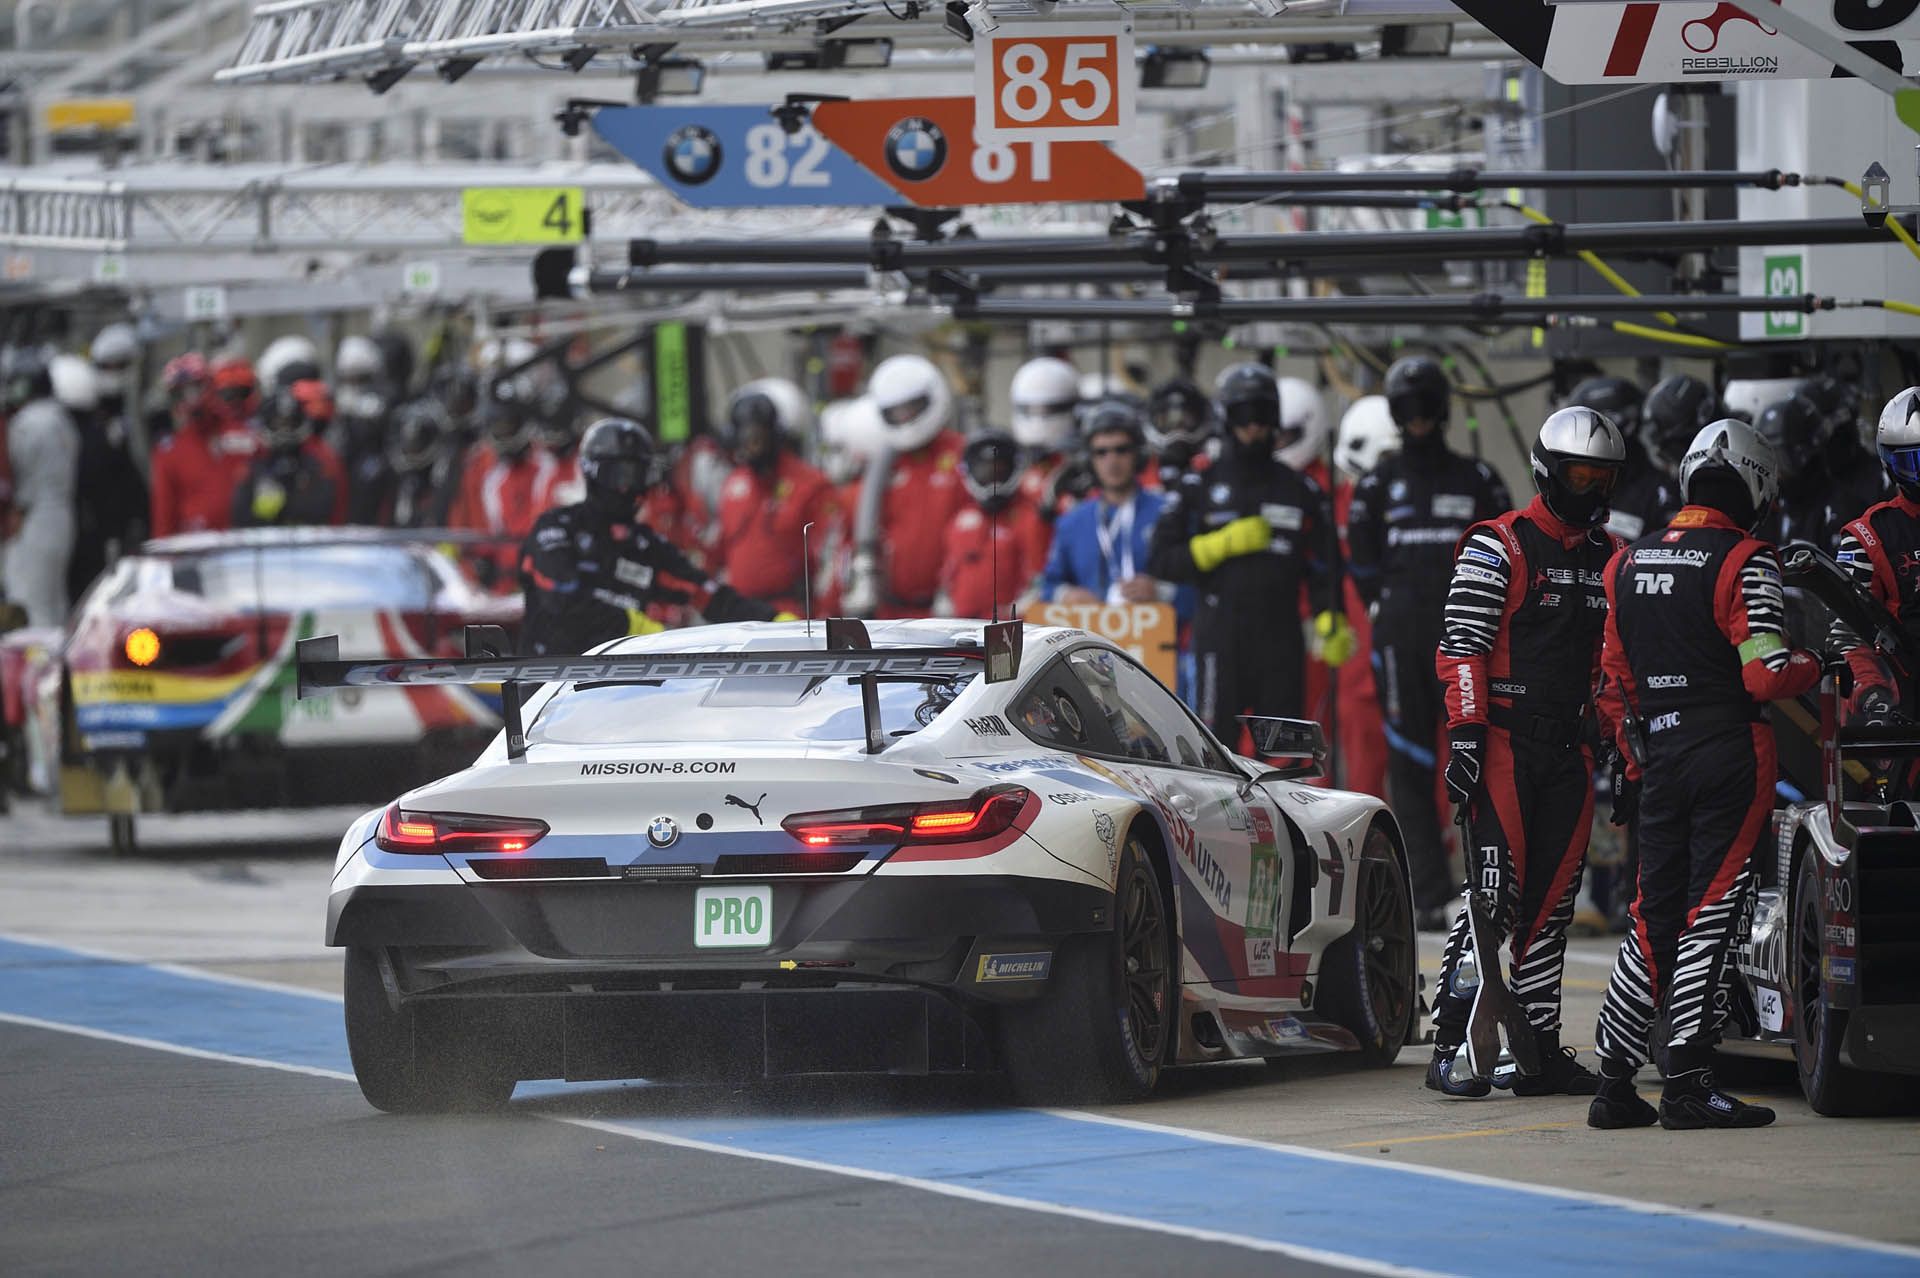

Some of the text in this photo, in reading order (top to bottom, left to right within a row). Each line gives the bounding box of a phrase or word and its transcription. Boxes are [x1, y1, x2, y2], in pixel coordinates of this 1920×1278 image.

[1682, 56, 1778, 68] REBELLION
[1000, 43, 1111, 122] 85
[744, 124, 831, 188] 82
[543, 190, 571, 235] 4
[1634, 549, 1709, 562] REBELLION
[1634, 573, 1675, 594] TVR
[1044, 603, 1161, 640] STOP
[472, 656, 966, 681] PERFORMANCE
[1648, 675, 1688, 688] sparco
[1649, 711, 1681, 734] MRTC
[580, 761, 736, 776] MISSION-8.COM
[1197, 842, 1231, 914] ULTRA
[704, 896, 763, 935] PRO
[999, 961, 1044, 973] MICHELIN
[1709, 1095, 1732, 1111] OMP
